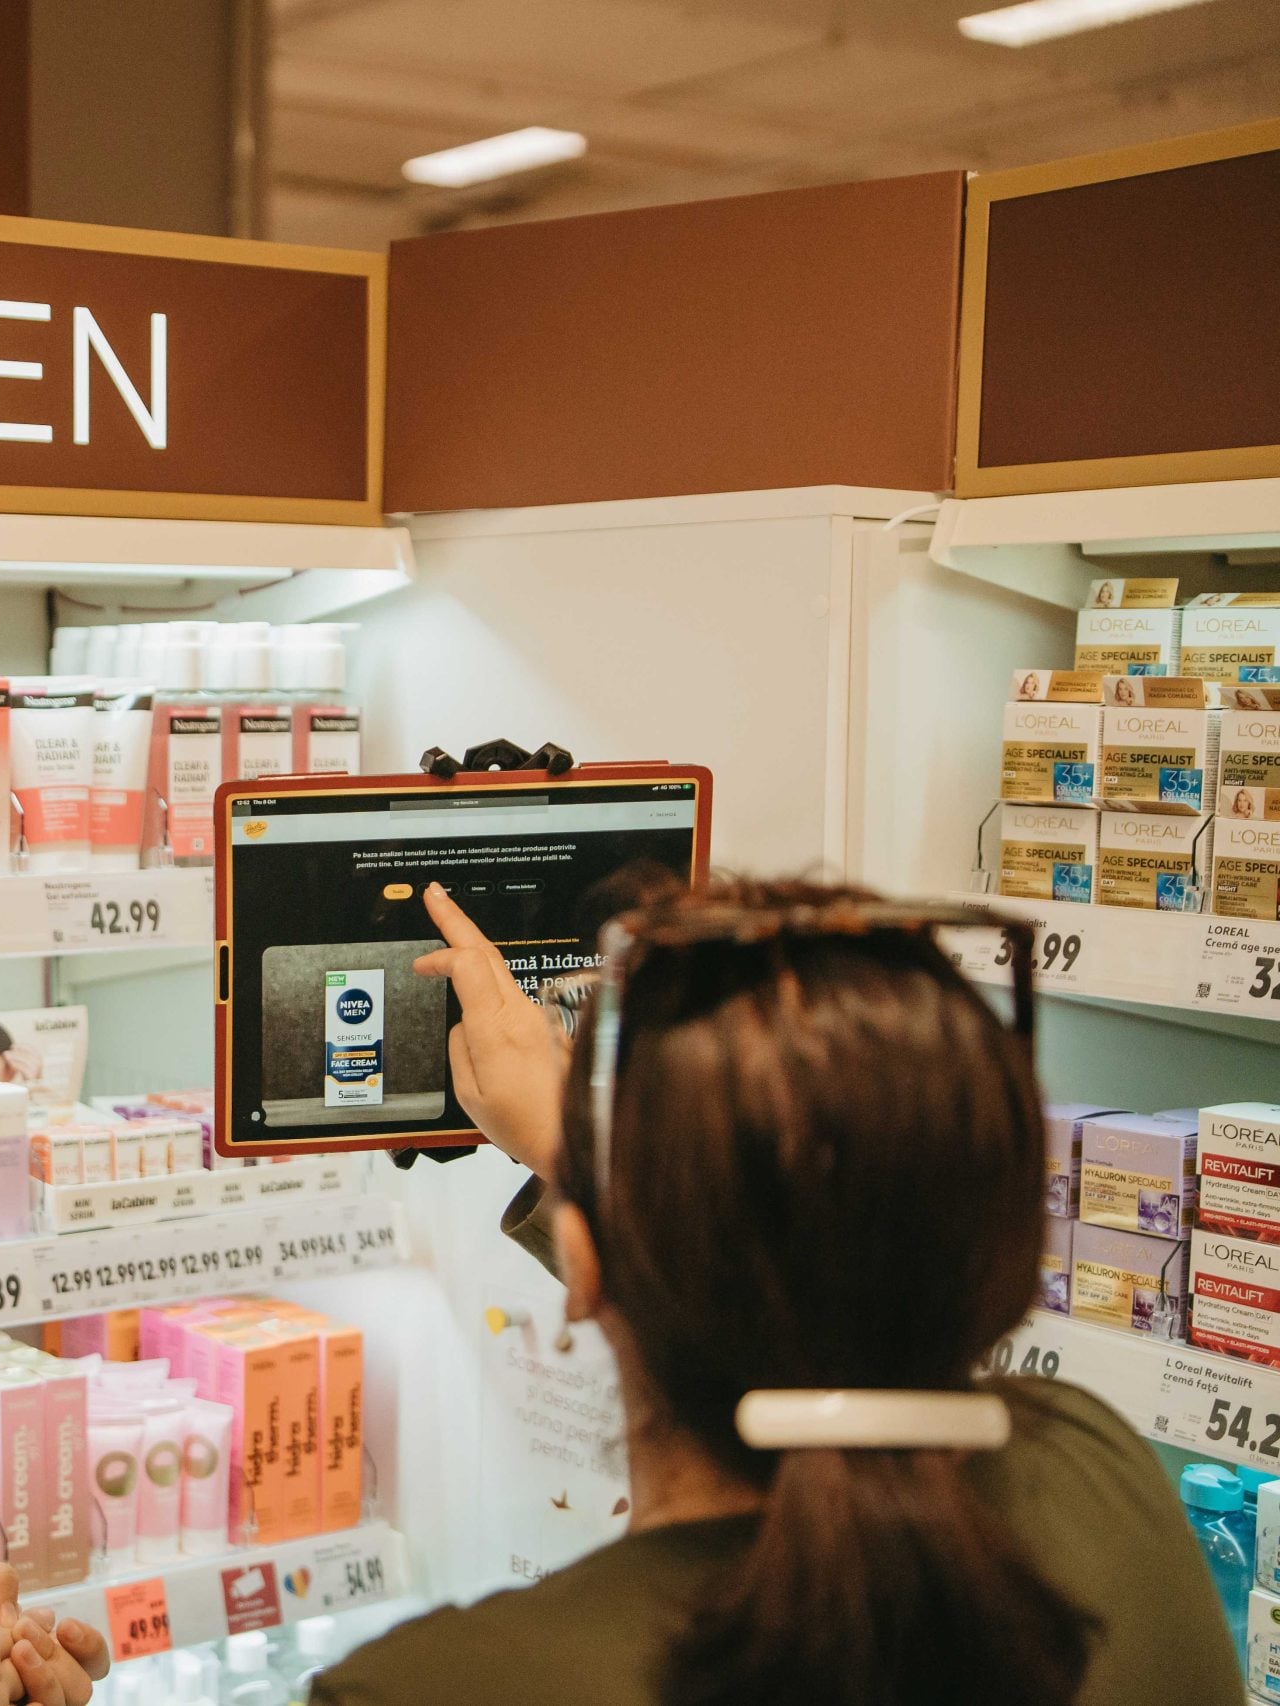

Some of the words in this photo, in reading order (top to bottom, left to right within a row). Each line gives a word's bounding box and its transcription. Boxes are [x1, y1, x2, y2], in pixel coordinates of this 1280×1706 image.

[1079, 651, 1098, 661] AGE
[1101, 651, 1159, 661] SPECIALIST
[1184, 653, 1206, 663] AGE
[1209, 653, 1272, 663] SPECIALIST
[1245, 668, 1279, 684] 35+
[1005, 749, 1023, 758] AGE
[1027, 750, 1086, 760] SPECIALIST
[1106, 753, 1127, 763] AGE
[1130, 754, 1193, 765] SPECIALIST
[1225, 754, 1250, 765] AGE
[379, 850, 403, 858] analizei
[404, 849, 426, 857] tenului
[522, 845, 548, 853] produse
[549, 844, 577, 852] potrivite
[1003, 848, 1023, 857] AGE
[1026, 848, 1084, 861] SPECIALIST
[440, 858, 468, 866] adaptate
[496, 855, 531, 863] individuale
[542, 854, 558, 862] pielii
[1103, 855, 1124, 866] AGE
[1127, 857, 1191, 871] SPECIALIST
[1219, 860, 1242, 871] AGE
[1161, 875, 1187, 898] 35
[91, 899, 161, 935] 42.99
[1207, 924, 1251, 938] LOREAL
[1205, 937, 1239, 950] Cremă
[1240, 943, 1260, 954] age
[504, 956, 538, 971] emă
[541, 953, 610, 969] hidrata
[340, 1000, 371, 1009] NIVEA
[337, 1033, 372, 1042] SENSITIVE
[331, 1060, 350, 1068] FACE
[351, 1059, 378, 1067] CREAM
[338, 1090, 344, 1099] 5
[1211, 1123, 1280, 1147] L'ORÉA
[1235, 1141, 1264, 1152] PARIS
[1204, 1158, 1275, 1181] REVITALIFT
[1084, 1168, 1127, 1183] HYALURON
[1128, 1176, 1173, 1191] SPECIALIST
[1205, 1179, 1240, 1193] Hydrating
[1241, 1186, 1266, 1196] Cream
[1224, 1205, 1243, 1213] results
[1257, 1209, 1271, 1218] days
[181, 1251, 220, 1276] 12.99
[225, 1245, 264, 1269] 12.99
[1203, 1242, 1279, 1271] L'ORÉAL
[96, 1262, 137, 1288] 12.99
[138, 1256, 178, 1282] 12.99
[1076, 1262, 1121, 1280] HYALURON
[1226, 1263, 1255, 1274] PARIS
[51, 1268, 93, 1295] 12.99
[1197, 1278, 1265, 1303] REVITALIFT
[1197, 1299, 1230, 1313] Hydrating
[1231, 1306, 1255, 1317] Cream
[1216, 1325, 1234, 1335] results
[1246, 1332, 1260, 1340] days
[1163, 1372, 1194, 1386] cremă
[1166, 1358, 1172, 1368] L
[1174, 1360, 1203, 1376] Oreal
[1204, 1368, 1254, 1388] Revitalift
[1205, 1398, 1280, 1458] 54.2
[51, 1502, 74, 1540] bb
[6, 1513, 29, 1549] bb
